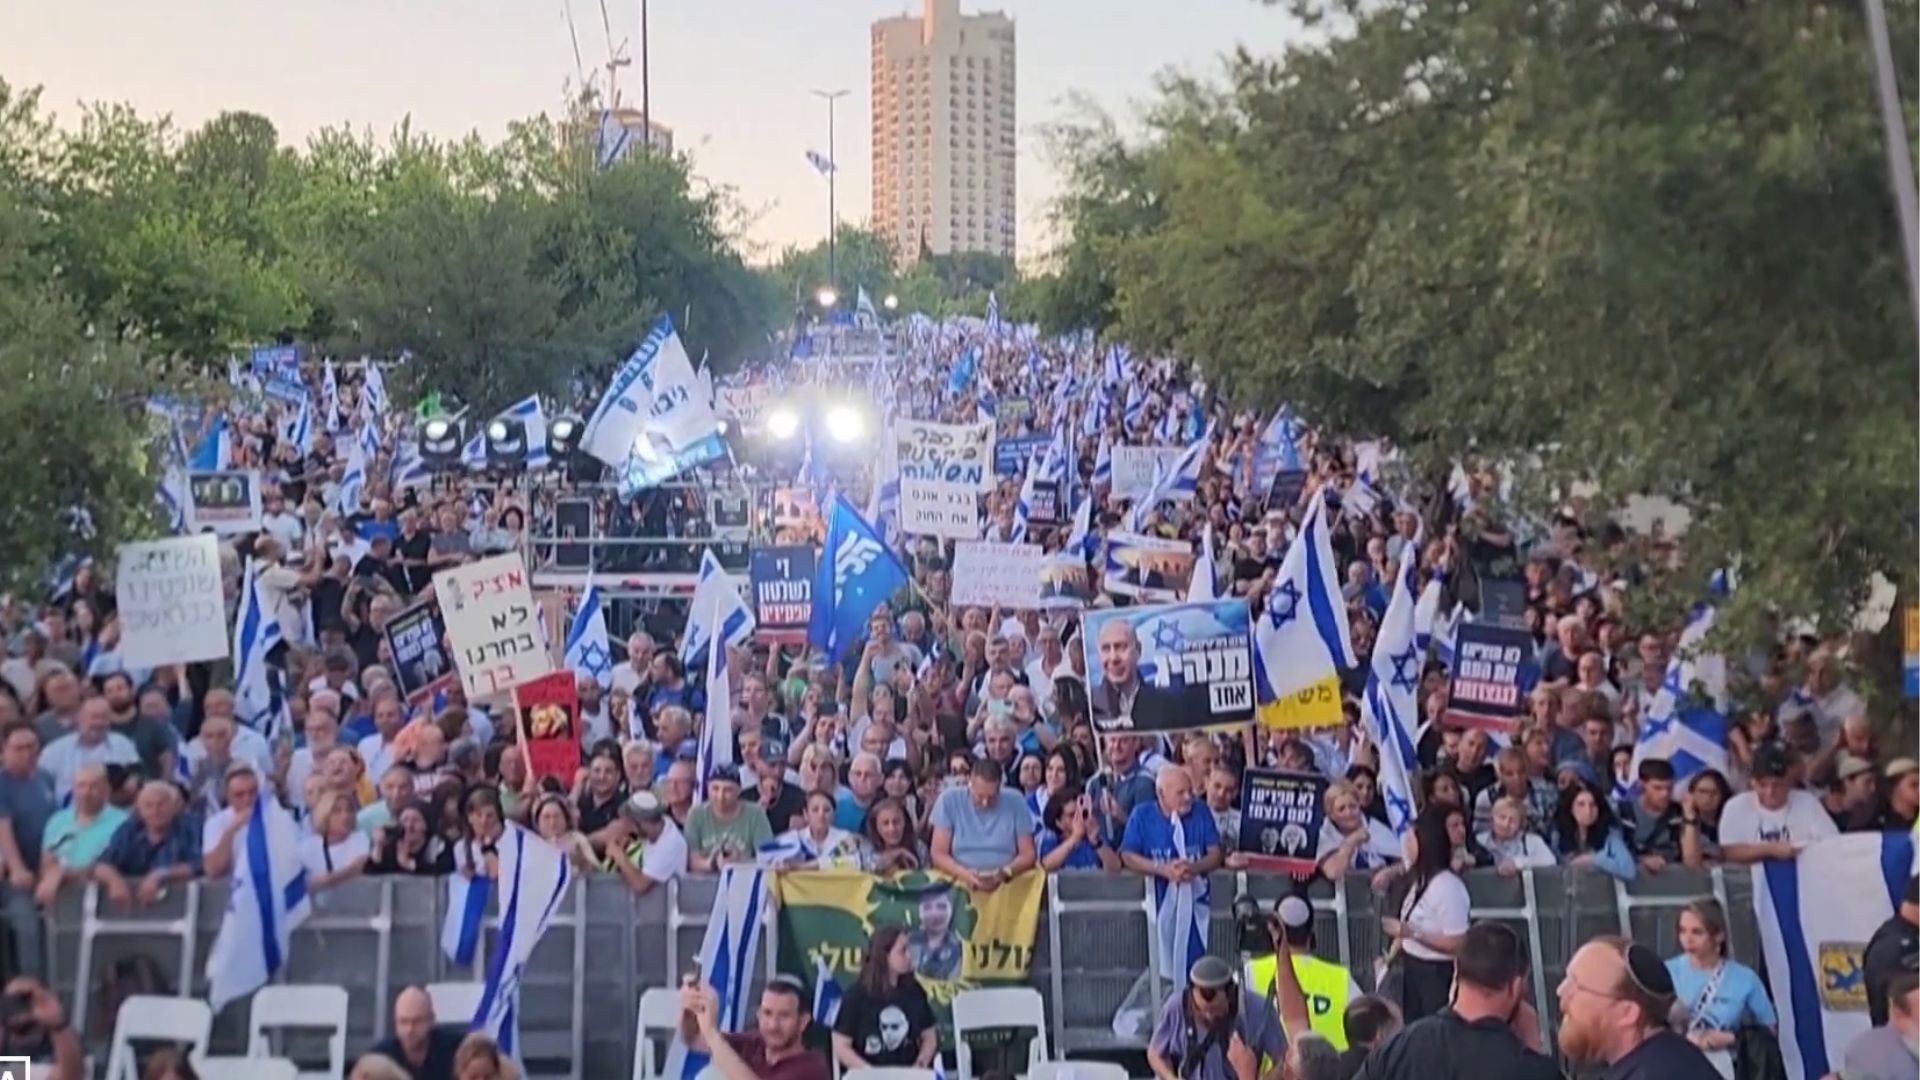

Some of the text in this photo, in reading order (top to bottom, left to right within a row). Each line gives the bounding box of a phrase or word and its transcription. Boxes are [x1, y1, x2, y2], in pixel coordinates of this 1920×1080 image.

[776, 558, 790, 579] די
[758, 578, 811, 602] לשלטון
[491, 605, 529, 633] לא
[465, 633, 535, 666] בחרנו
[1154, 646, 1250, 689] מנהיג
[1297, 791, 1315, 808] לא
